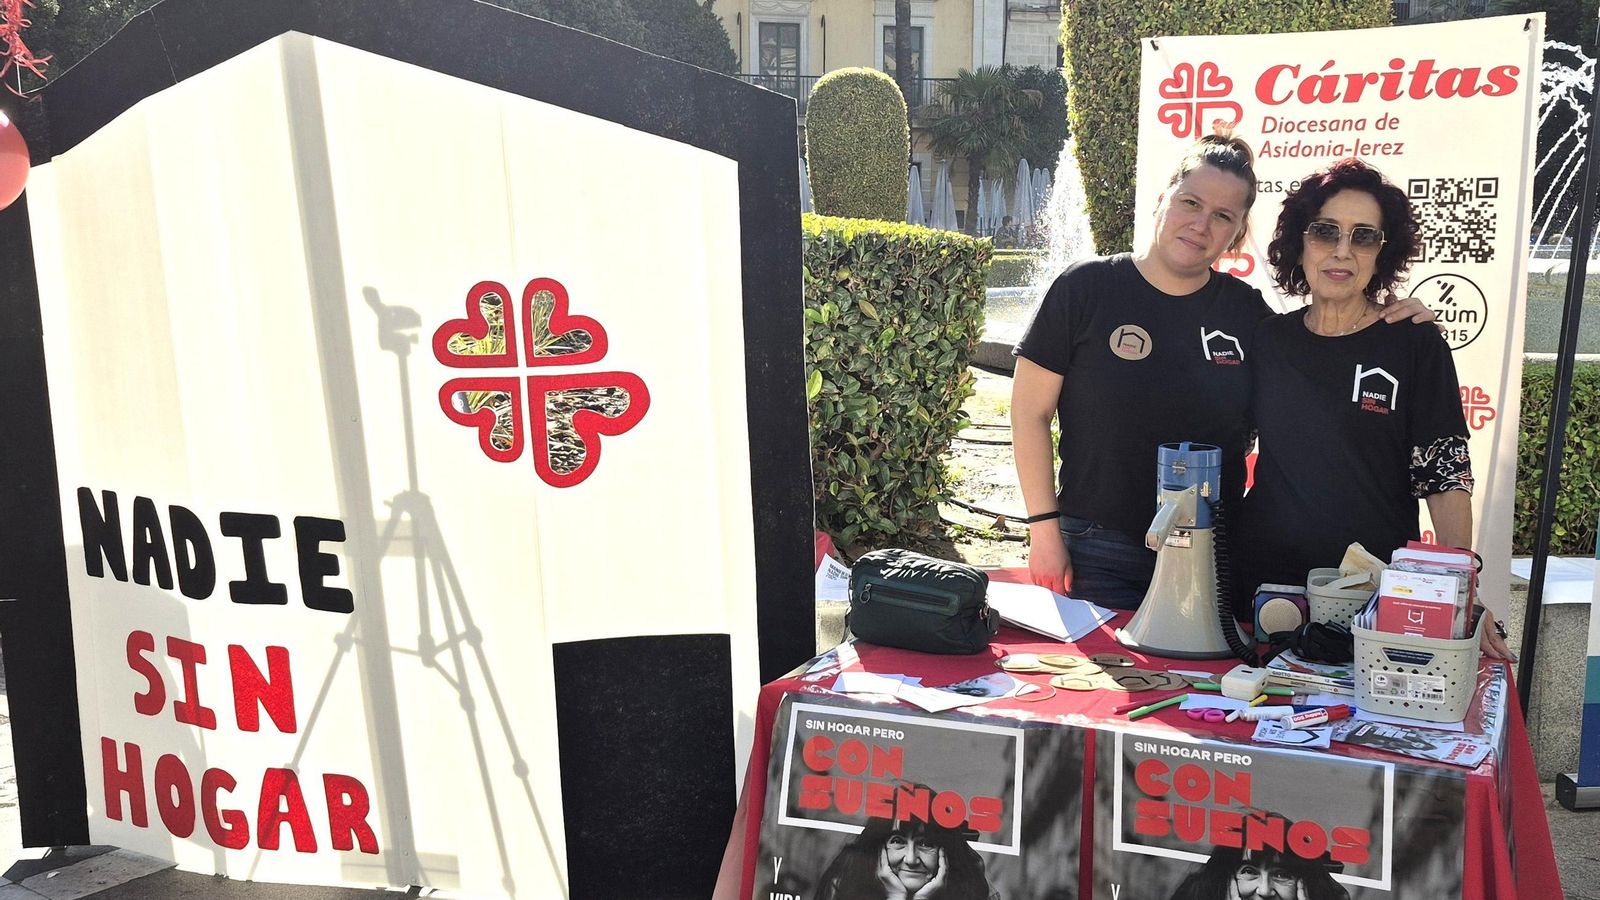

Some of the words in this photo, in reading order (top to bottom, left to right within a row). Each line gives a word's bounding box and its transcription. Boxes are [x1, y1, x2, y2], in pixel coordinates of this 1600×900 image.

[1255, 58, 1520, 105] Cáritas
[1261, 115, 1367, 134] Diocesana
[1375, 112, 1400, 130] de
[1258, 138, 1405, 158] Asidonia-Jerez
[1256, 180, 1301, 193] tas.e
[1440, 329, 1468, 341] 315
[1361, 397, 1376, 405] SIN
[1362, 391, 1387, 401] NADIE
[1361, 404, 1389, 415] HOGAR
[77, 486, 354, 614] NADIE
[126, 630, 297, 734] SIN
[806, 719, 825, 731] SIN
[828, 721, 871, 737] HOGAR
[873, 728, 905, 740] PERO
[803, 735, 904, 779] CON
[1134, 742, 1157, 753] SIN
[1160, 744, 1210, 761] HOGAR
[1214, 752, 1252, 766] PERO
[1134, 759, 1252, 805] CON
[101, 736, 379, 855] HOGAR
[799, 774, 1004, 833] SUEÑOS
[1134, 798, 1371, 865] SUEÑOS
[773, 856, 783, 885] Y
